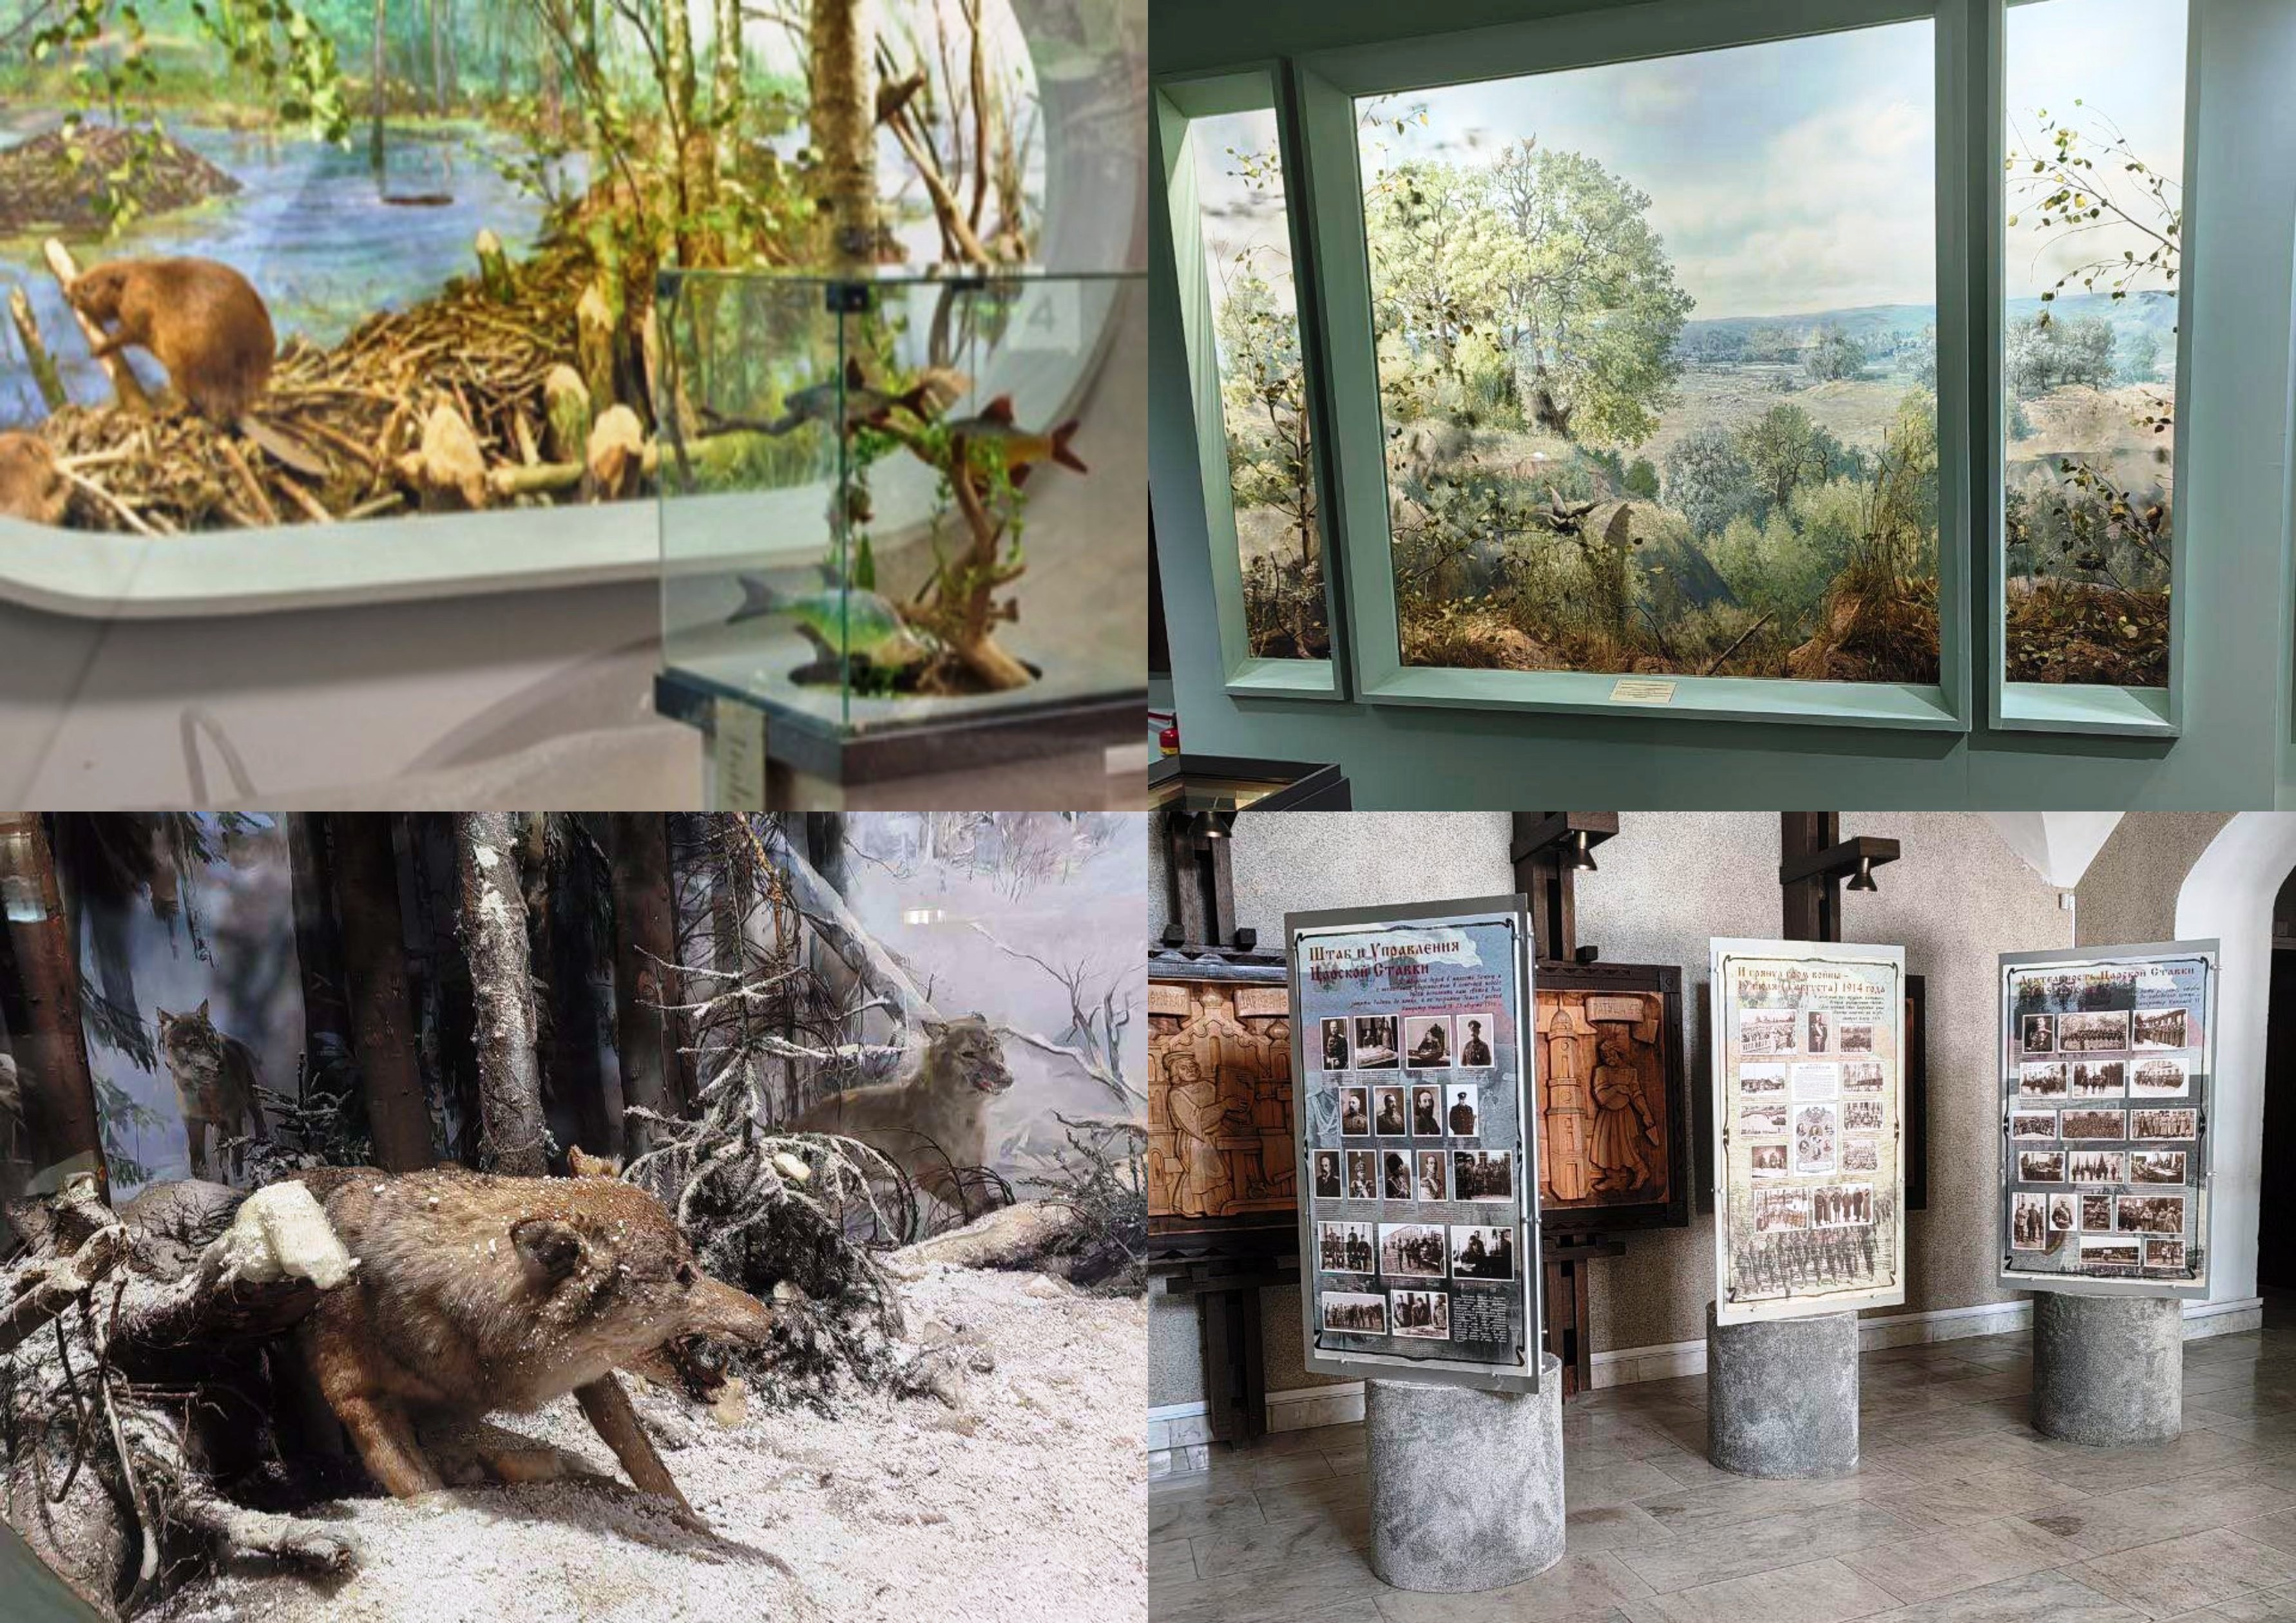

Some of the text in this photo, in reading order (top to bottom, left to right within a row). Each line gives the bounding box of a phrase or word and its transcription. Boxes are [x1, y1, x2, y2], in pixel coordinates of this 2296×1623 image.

[1028, 294, 1057, 333] 4
[1309, 942, 1460, 961] Штаб и Управления
[1310, 963, 1429, 982] Царской Ставки
[1738, 967, 1746, 978] И
[2150, 967, 2194, 976] Ставки
[1842, 982, 1863, 992] 1914
[1866, 984, 1886, 994] года
